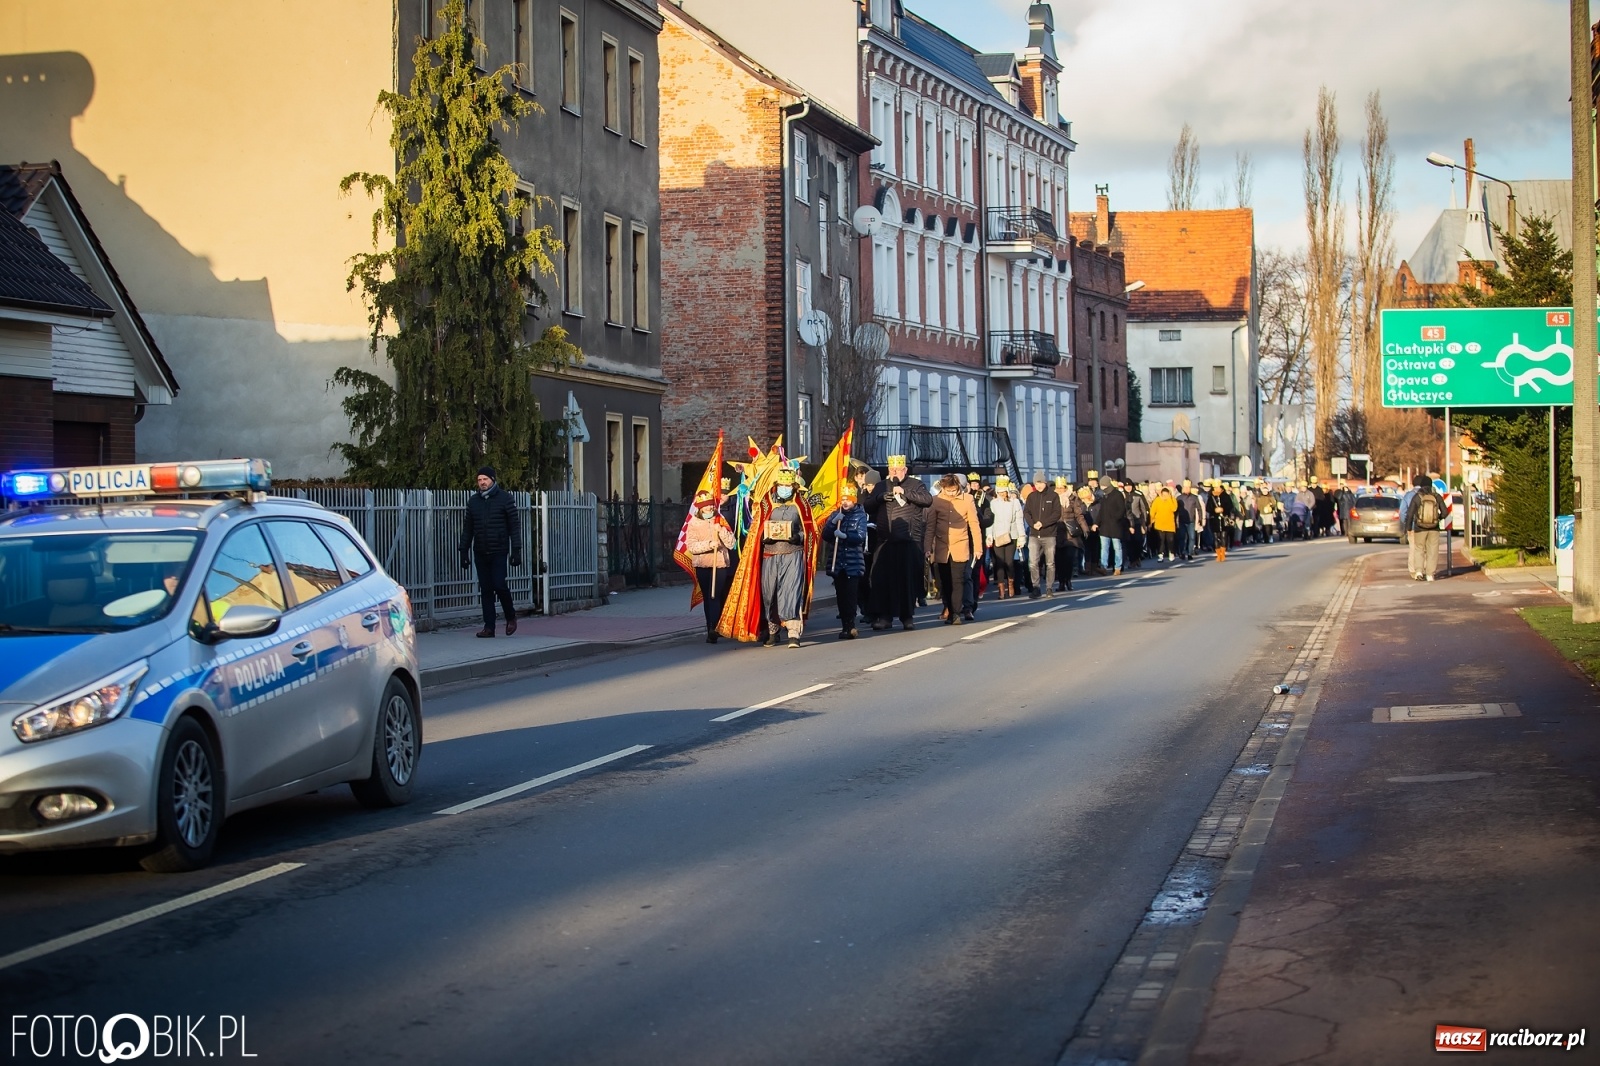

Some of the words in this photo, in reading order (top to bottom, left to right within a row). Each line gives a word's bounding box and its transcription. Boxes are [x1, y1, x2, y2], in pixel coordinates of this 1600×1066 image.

[1551, 314, 1565, 324] 45
[1426, 328, 1440, 338] 45
[1385, 342, 1444, 357] Chałupki
[1386, 358, 1436, 371] Ostrava
[1386, 373, 1429, 389] Opava
[72, 470, 147, 491] POLICJA
[234, 652, 286, 695] POLICJA
